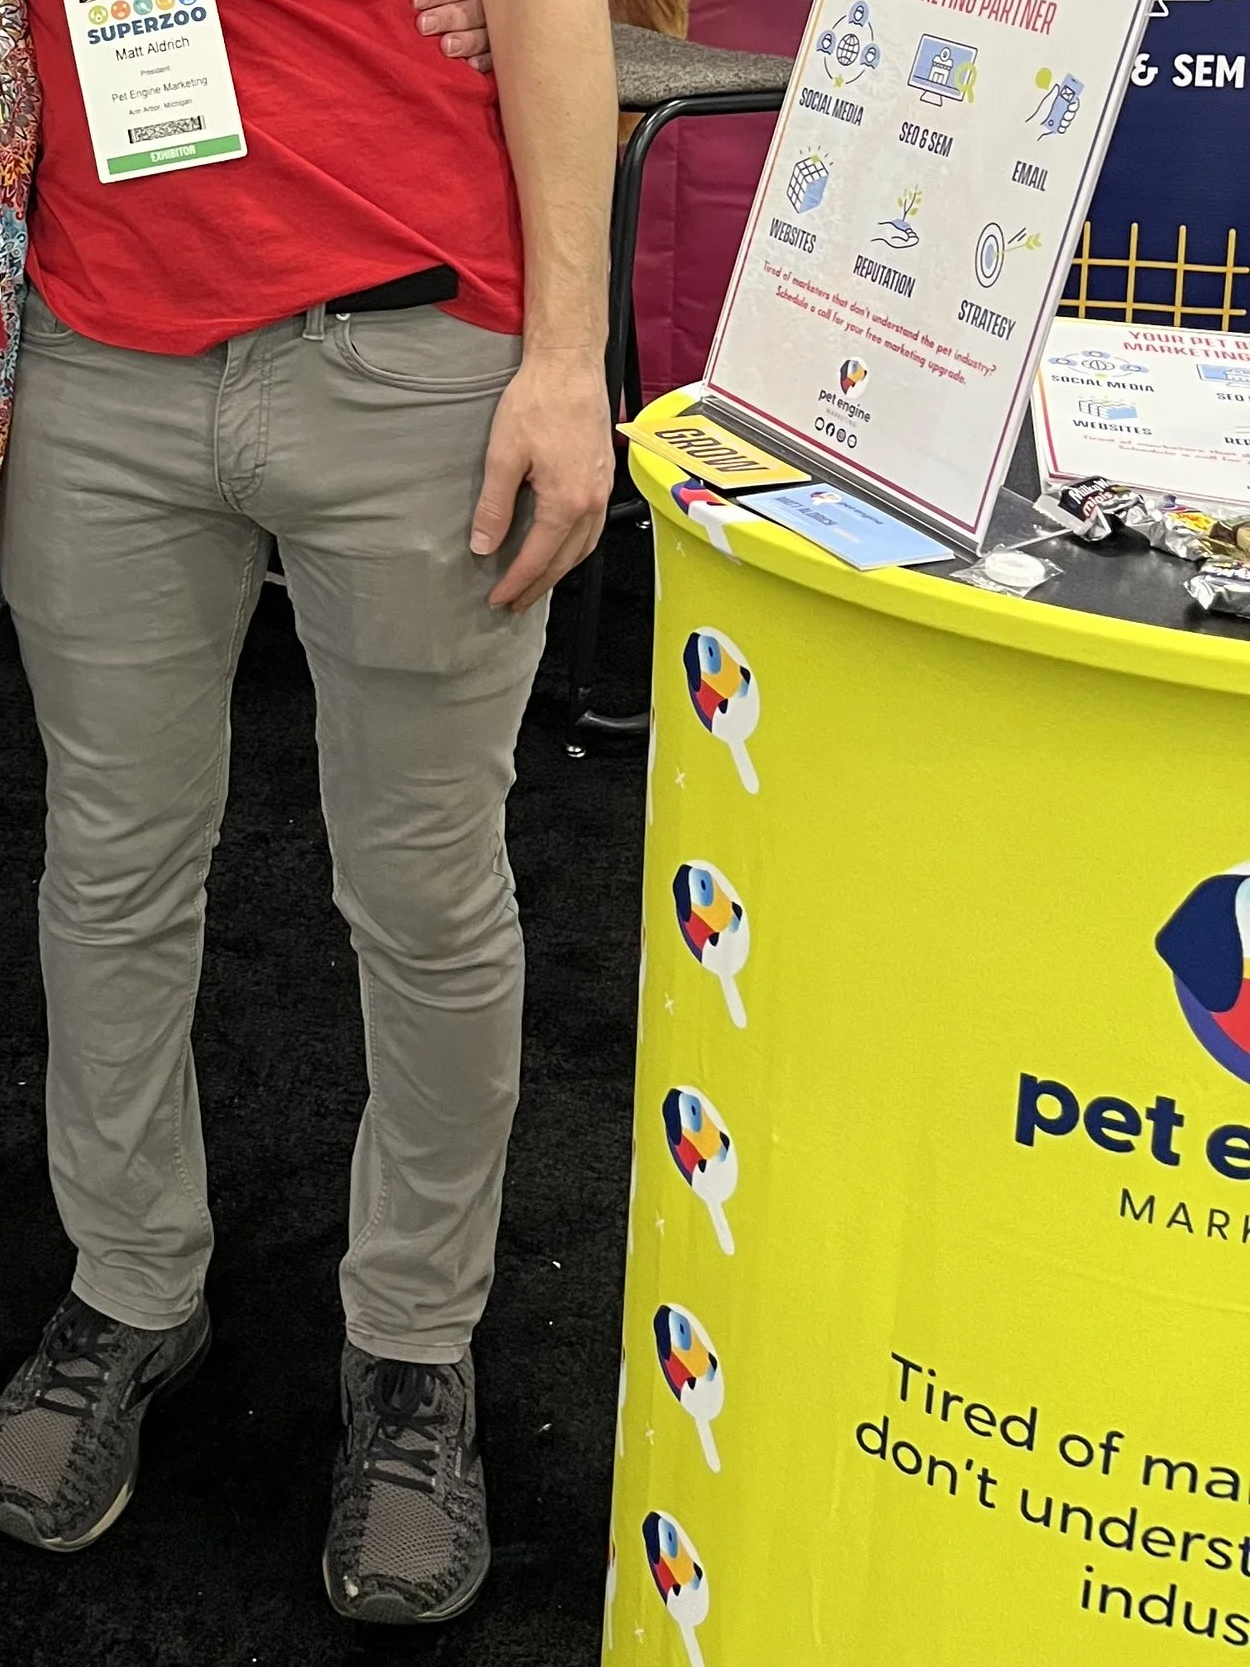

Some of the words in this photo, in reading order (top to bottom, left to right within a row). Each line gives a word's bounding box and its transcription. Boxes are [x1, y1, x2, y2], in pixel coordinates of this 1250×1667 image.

[87, 6, 207, 45] SUPERZOO
[115, 45, 144, 62] Matt
[147, 36, 190, 55] Aldrich
[1172, 53, 1246, 89] SEM
[111, 91, 128, 103] Pet
[129, 85, 161, 101] Engine
[163, 76, 208, 93] Marketing
[799, 87, 833, 118] SOCIAL
[832, 97, 864, 126] MEDIA
[150, 145, 197, 162] EXHIBITOR
[899, 121, 920, 146] SEO
[928, 131, 954, 158] SEM
[1011, 160, 1049, 192] EMAIL
[769, 218, 817, 254] WEBSITES
[853, 254, 916, 298] REPUTATION
[872, 314, 920, 341] understand
[920, 334, 935, 349] the
[958, 299, 1016, 341] STRATEGY
[1123, 342, 1250, 362] MARKETING
[1128, 330, 1184, 345] YOUR
[1190, 337, 1227, 348] PET
[1051, 374, 1103, 388] SOCIAL
[1107, 381, 1155, 392] MEDIA
[1216, 392, 1244, 402] SEO
[818, 389, 836, 405] pet
[837, 397, 871, 423] engine
[1072, 419, 1152, 435] WEBSITES
[654, 428, 769, 473] GROW
[1013, 1072, 1185, 1166] pet
[891, 1351, 1038, 1452] Tired
[1059, 1431, 1124, 1475] of
[1141, 1453, 1250, 1506] ma
[855, 1415, 998, 1510] don't
